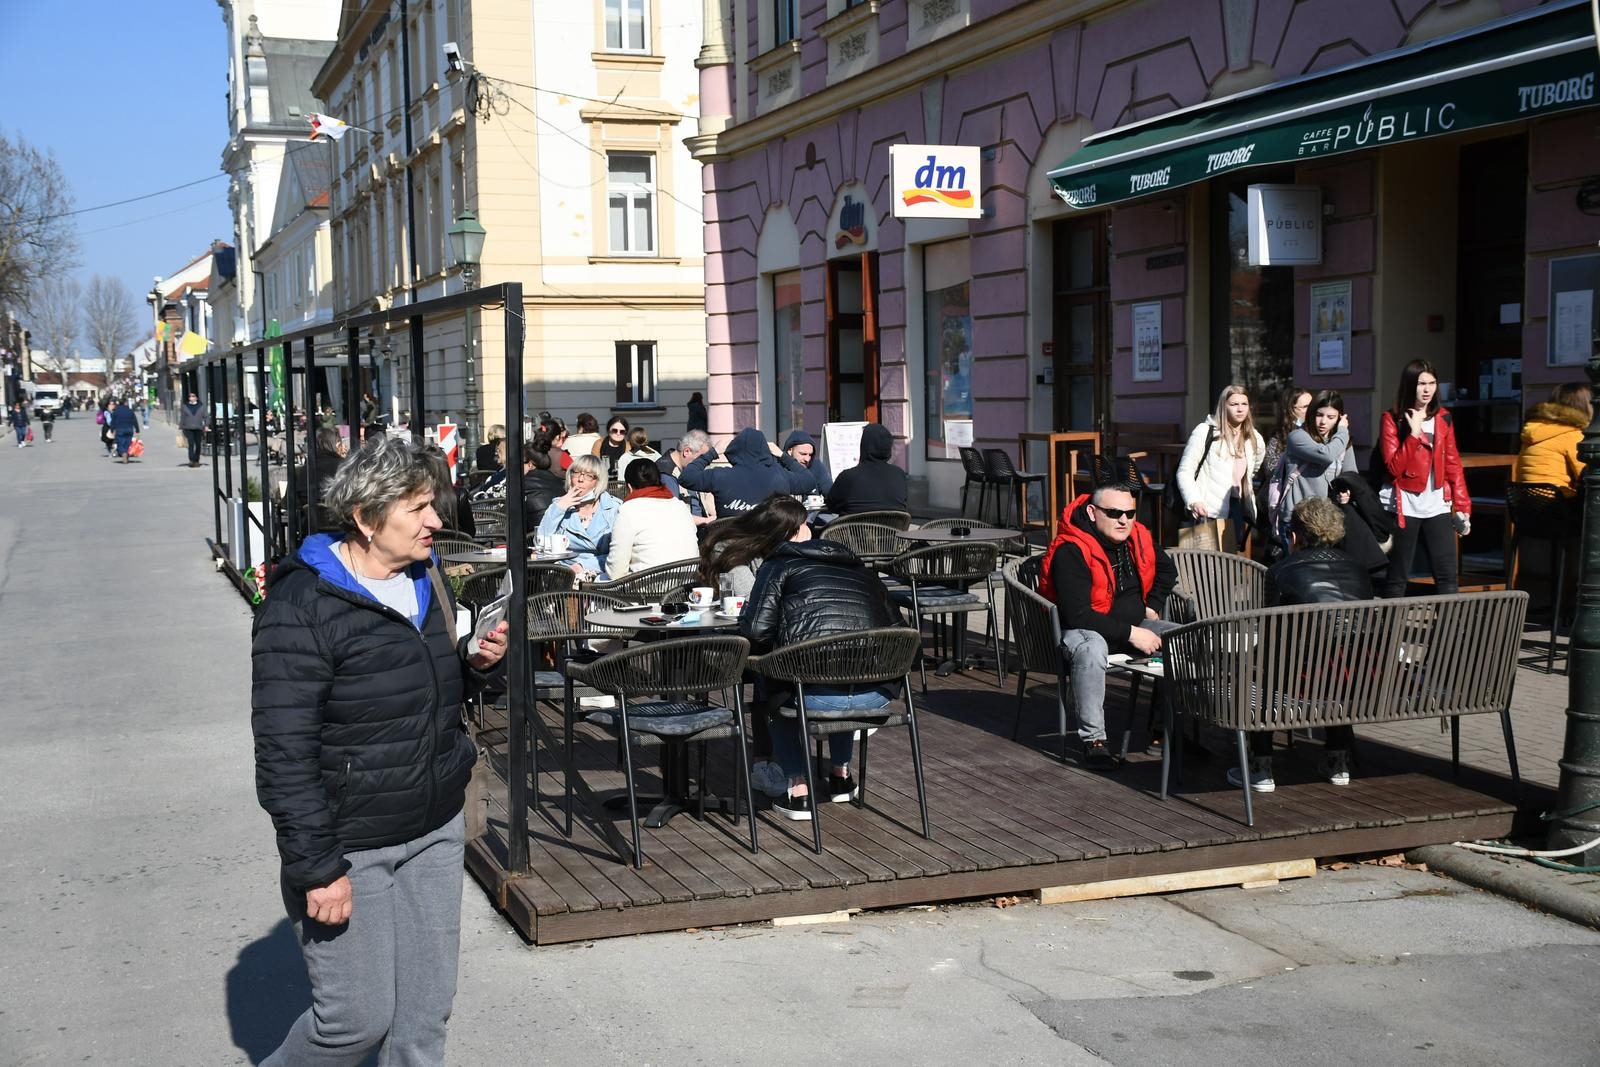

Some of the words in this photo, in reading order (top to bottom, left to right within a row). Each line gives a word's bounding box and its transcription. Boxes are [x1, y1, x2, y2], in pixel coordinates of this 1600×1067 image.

[1517, 72, 1594, 112] TUBORG
[1303, 128, 1332, 140] CAFFE
[1333, 103, 1456, 149] PUBLIC
[1206, 144, 1255, 173] TUBORG
[1298, 143, 1329, 155] BAR
[914, 155, 966, 189] dm
[1131, 166, 1170, 193] TUBORG
[839, 195, 865, 230] dm
[1267, 220, 1315, 230] PUBLIC
